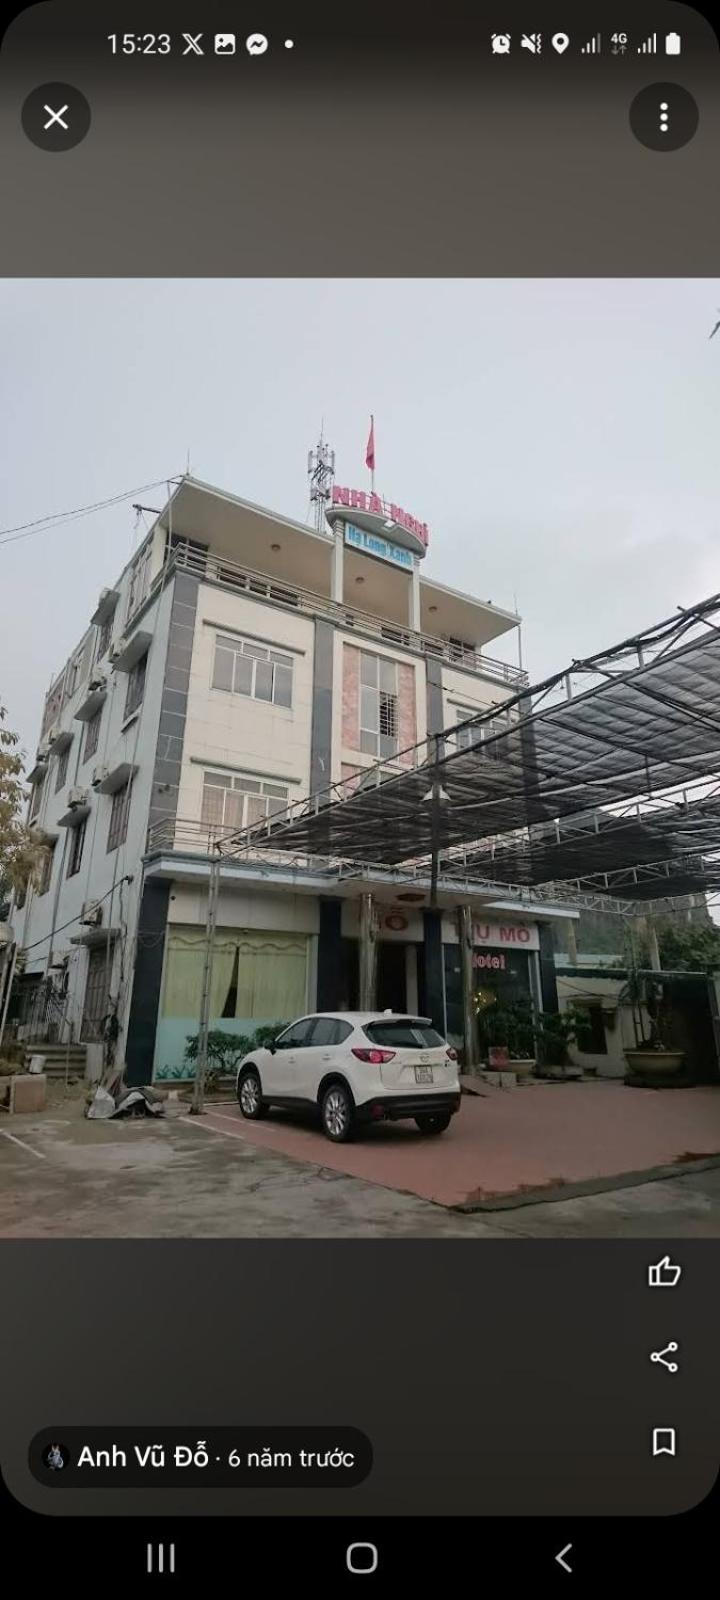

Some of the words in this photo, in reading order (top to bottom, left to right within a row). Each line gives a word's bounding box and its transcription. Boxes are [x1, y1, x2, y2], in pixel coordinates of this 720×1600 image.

[332, 485, 382, 514] NHÀ
[363, 534, 387, 556] Long
[389, 545, 413, 566] Xanh
